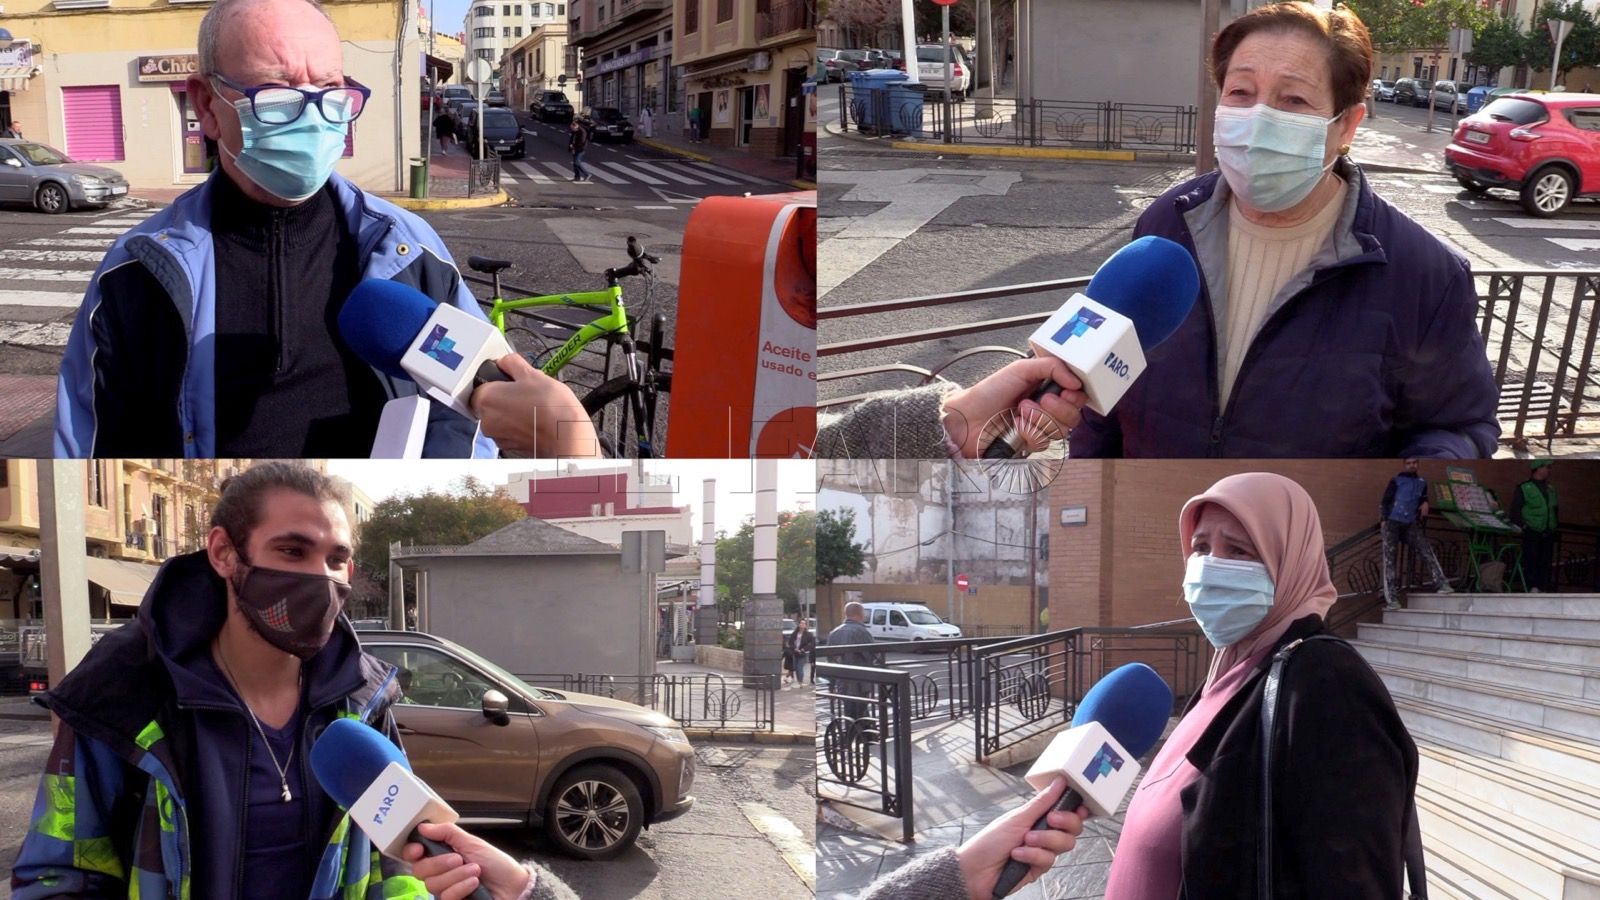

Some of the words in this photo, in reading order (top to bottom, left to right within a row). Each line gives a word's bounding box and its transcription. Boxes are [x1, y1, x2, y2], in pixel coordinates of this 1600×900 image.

[762, 340, 812, 363] Aceite
[761, 359, 803, 377] usado
[1103, 351, 1129, 378] FARO
[373, 784, 399, 824] FARO
